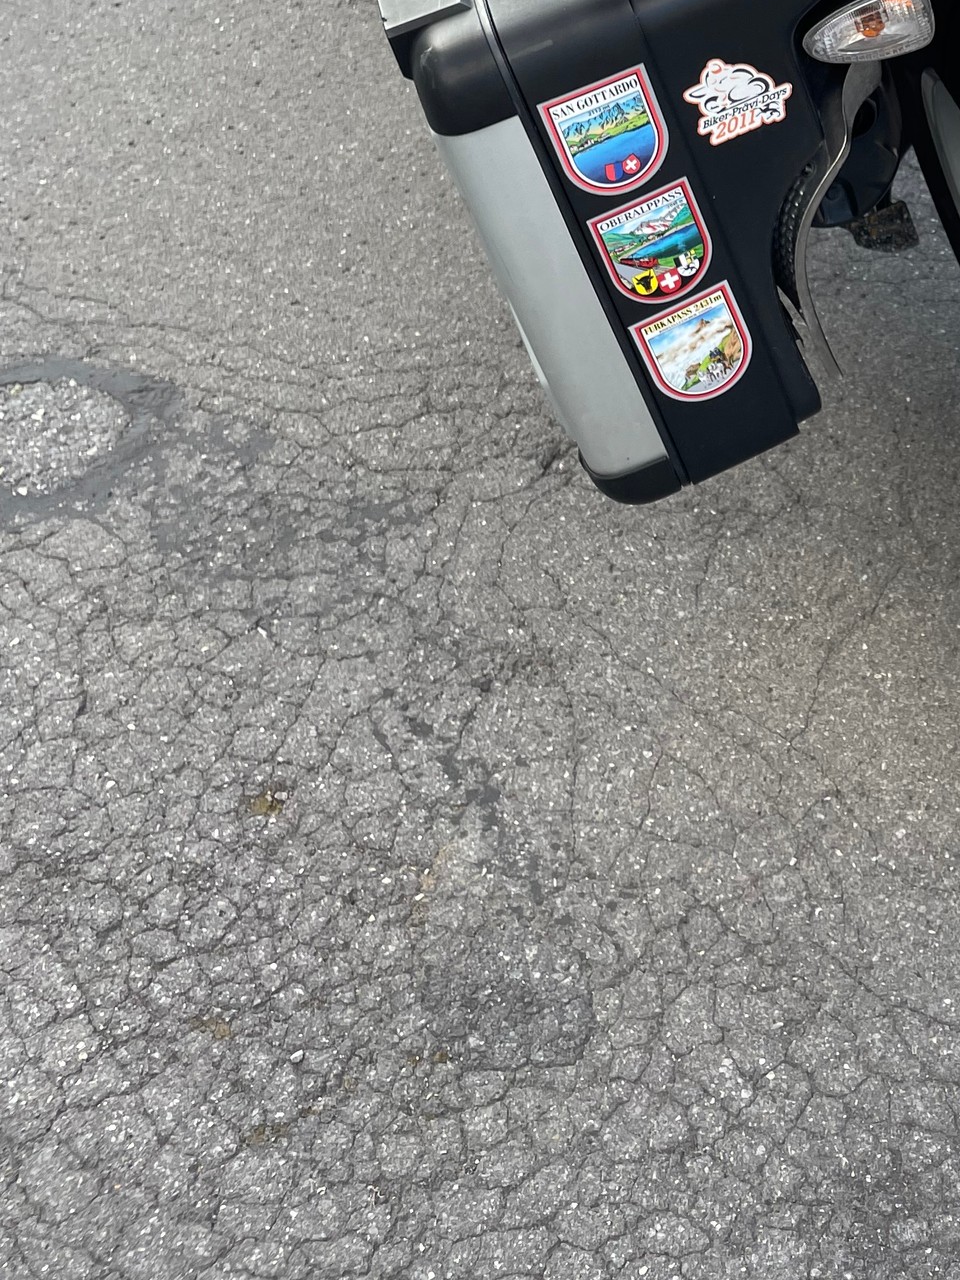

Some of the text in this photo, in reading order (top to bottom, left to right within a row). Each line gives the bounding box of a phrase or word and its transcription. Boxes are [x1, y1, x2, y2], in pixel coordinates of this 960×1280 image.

[552, 78, 638, 121] SAN GOTTARDO
[703, 87, 788, 130] Biker-Prävi-Days
[715, 109, 757, 140] 2011
[600, 188, 682, 232] OBERALPPASS
[644, 308, 693, 336] FURKAPASS
